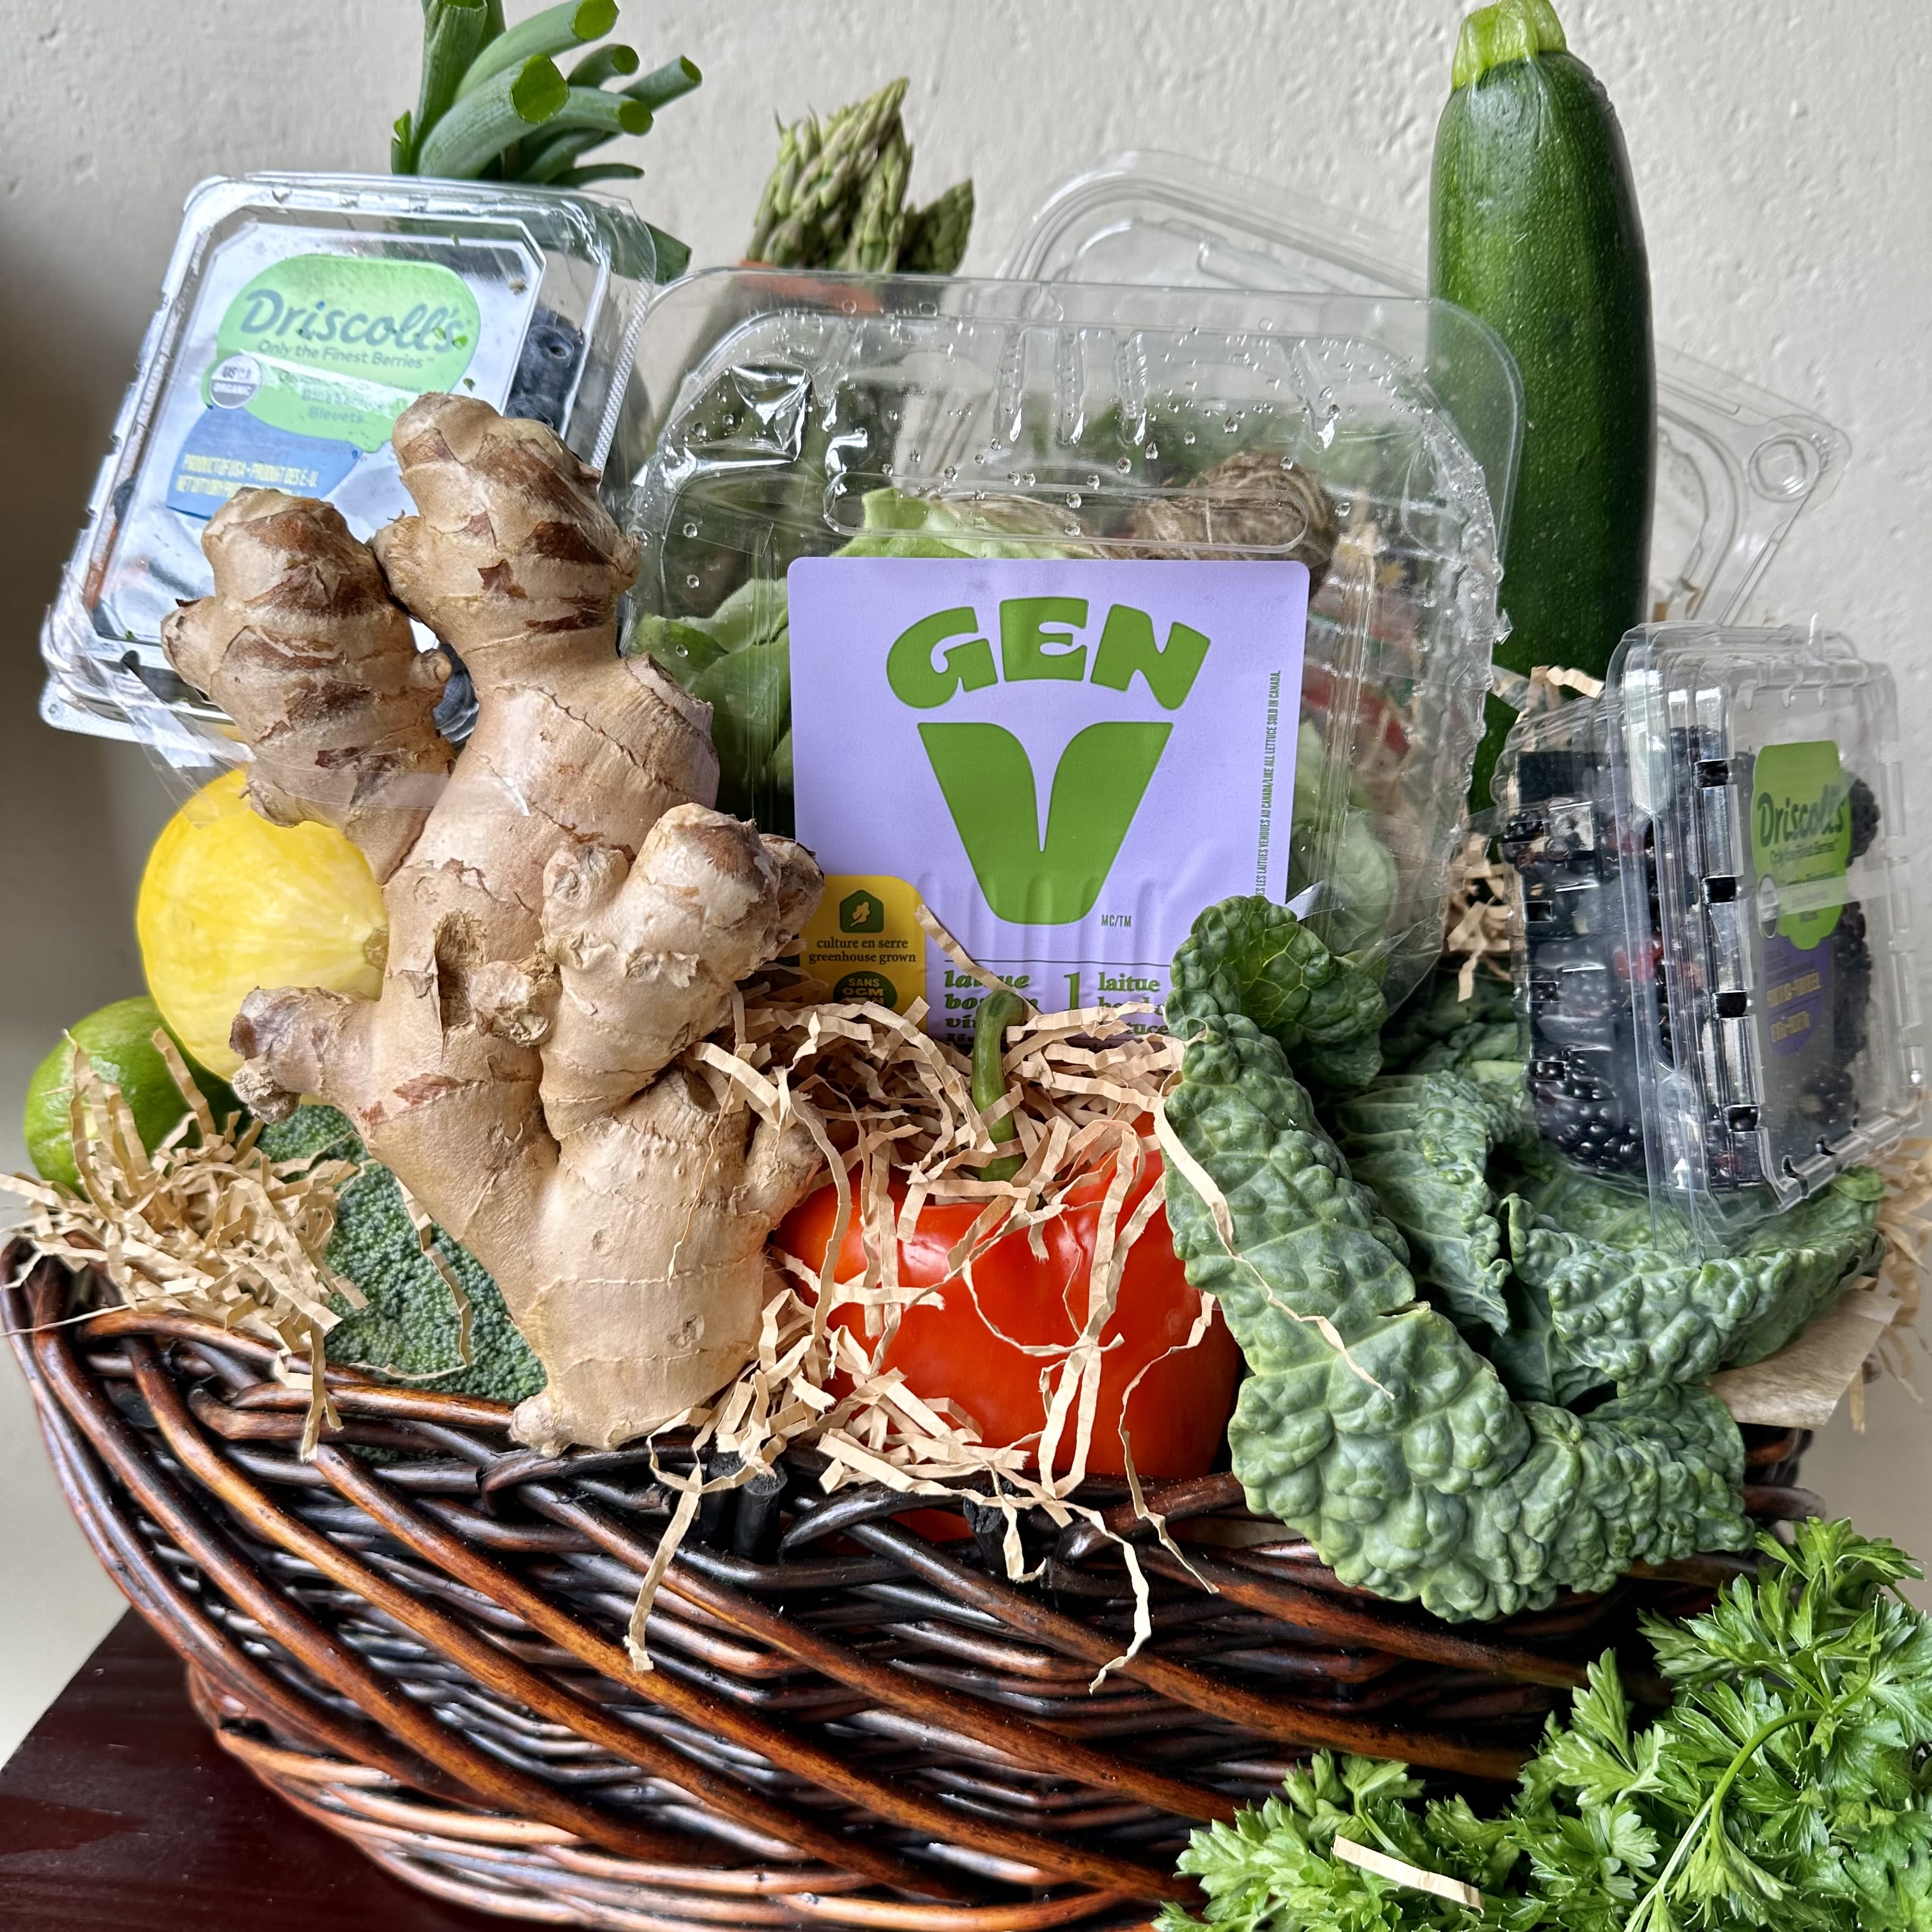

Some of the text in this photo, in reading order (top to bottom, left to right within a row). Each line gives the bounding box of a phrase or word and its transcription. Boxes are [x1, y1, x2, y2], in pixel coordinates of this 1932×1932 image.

[240, 289, 464, 355] Driscoll's
[258, 339, 295, 360] Only
[296, 343, 318, 358] the
[322, 346, 369, 364] Finest
[887, 597, 1211, 710] GEN
[1267, 709, 1278, 725] SOLD
[1265, 726, 1277, 754] LETTUCE
[1264, 755, 1275, 767] ALL
[917, 721, 1174, 926] V
[1261, 809, 1271, 818] AU
[1758, 785, 1845, 848] Driscoll's
[1259, 819, 1270, 847] VENDUES
[1257, 848, 1268, 874] LAITUES
[1256, 875, 1267, 886] LES
[1101, 914, 1132, 928] MC/TM
[816, 937, 908, 949] culture en serre
[809, 951, 917, 965] greenhouse grown
[848, 977, 880, 987] SANS
[1064, 971, 1080, 1011] 1
[1098, 971, 1161, 992] laitue
[843, 988, 884, 997] OGM
